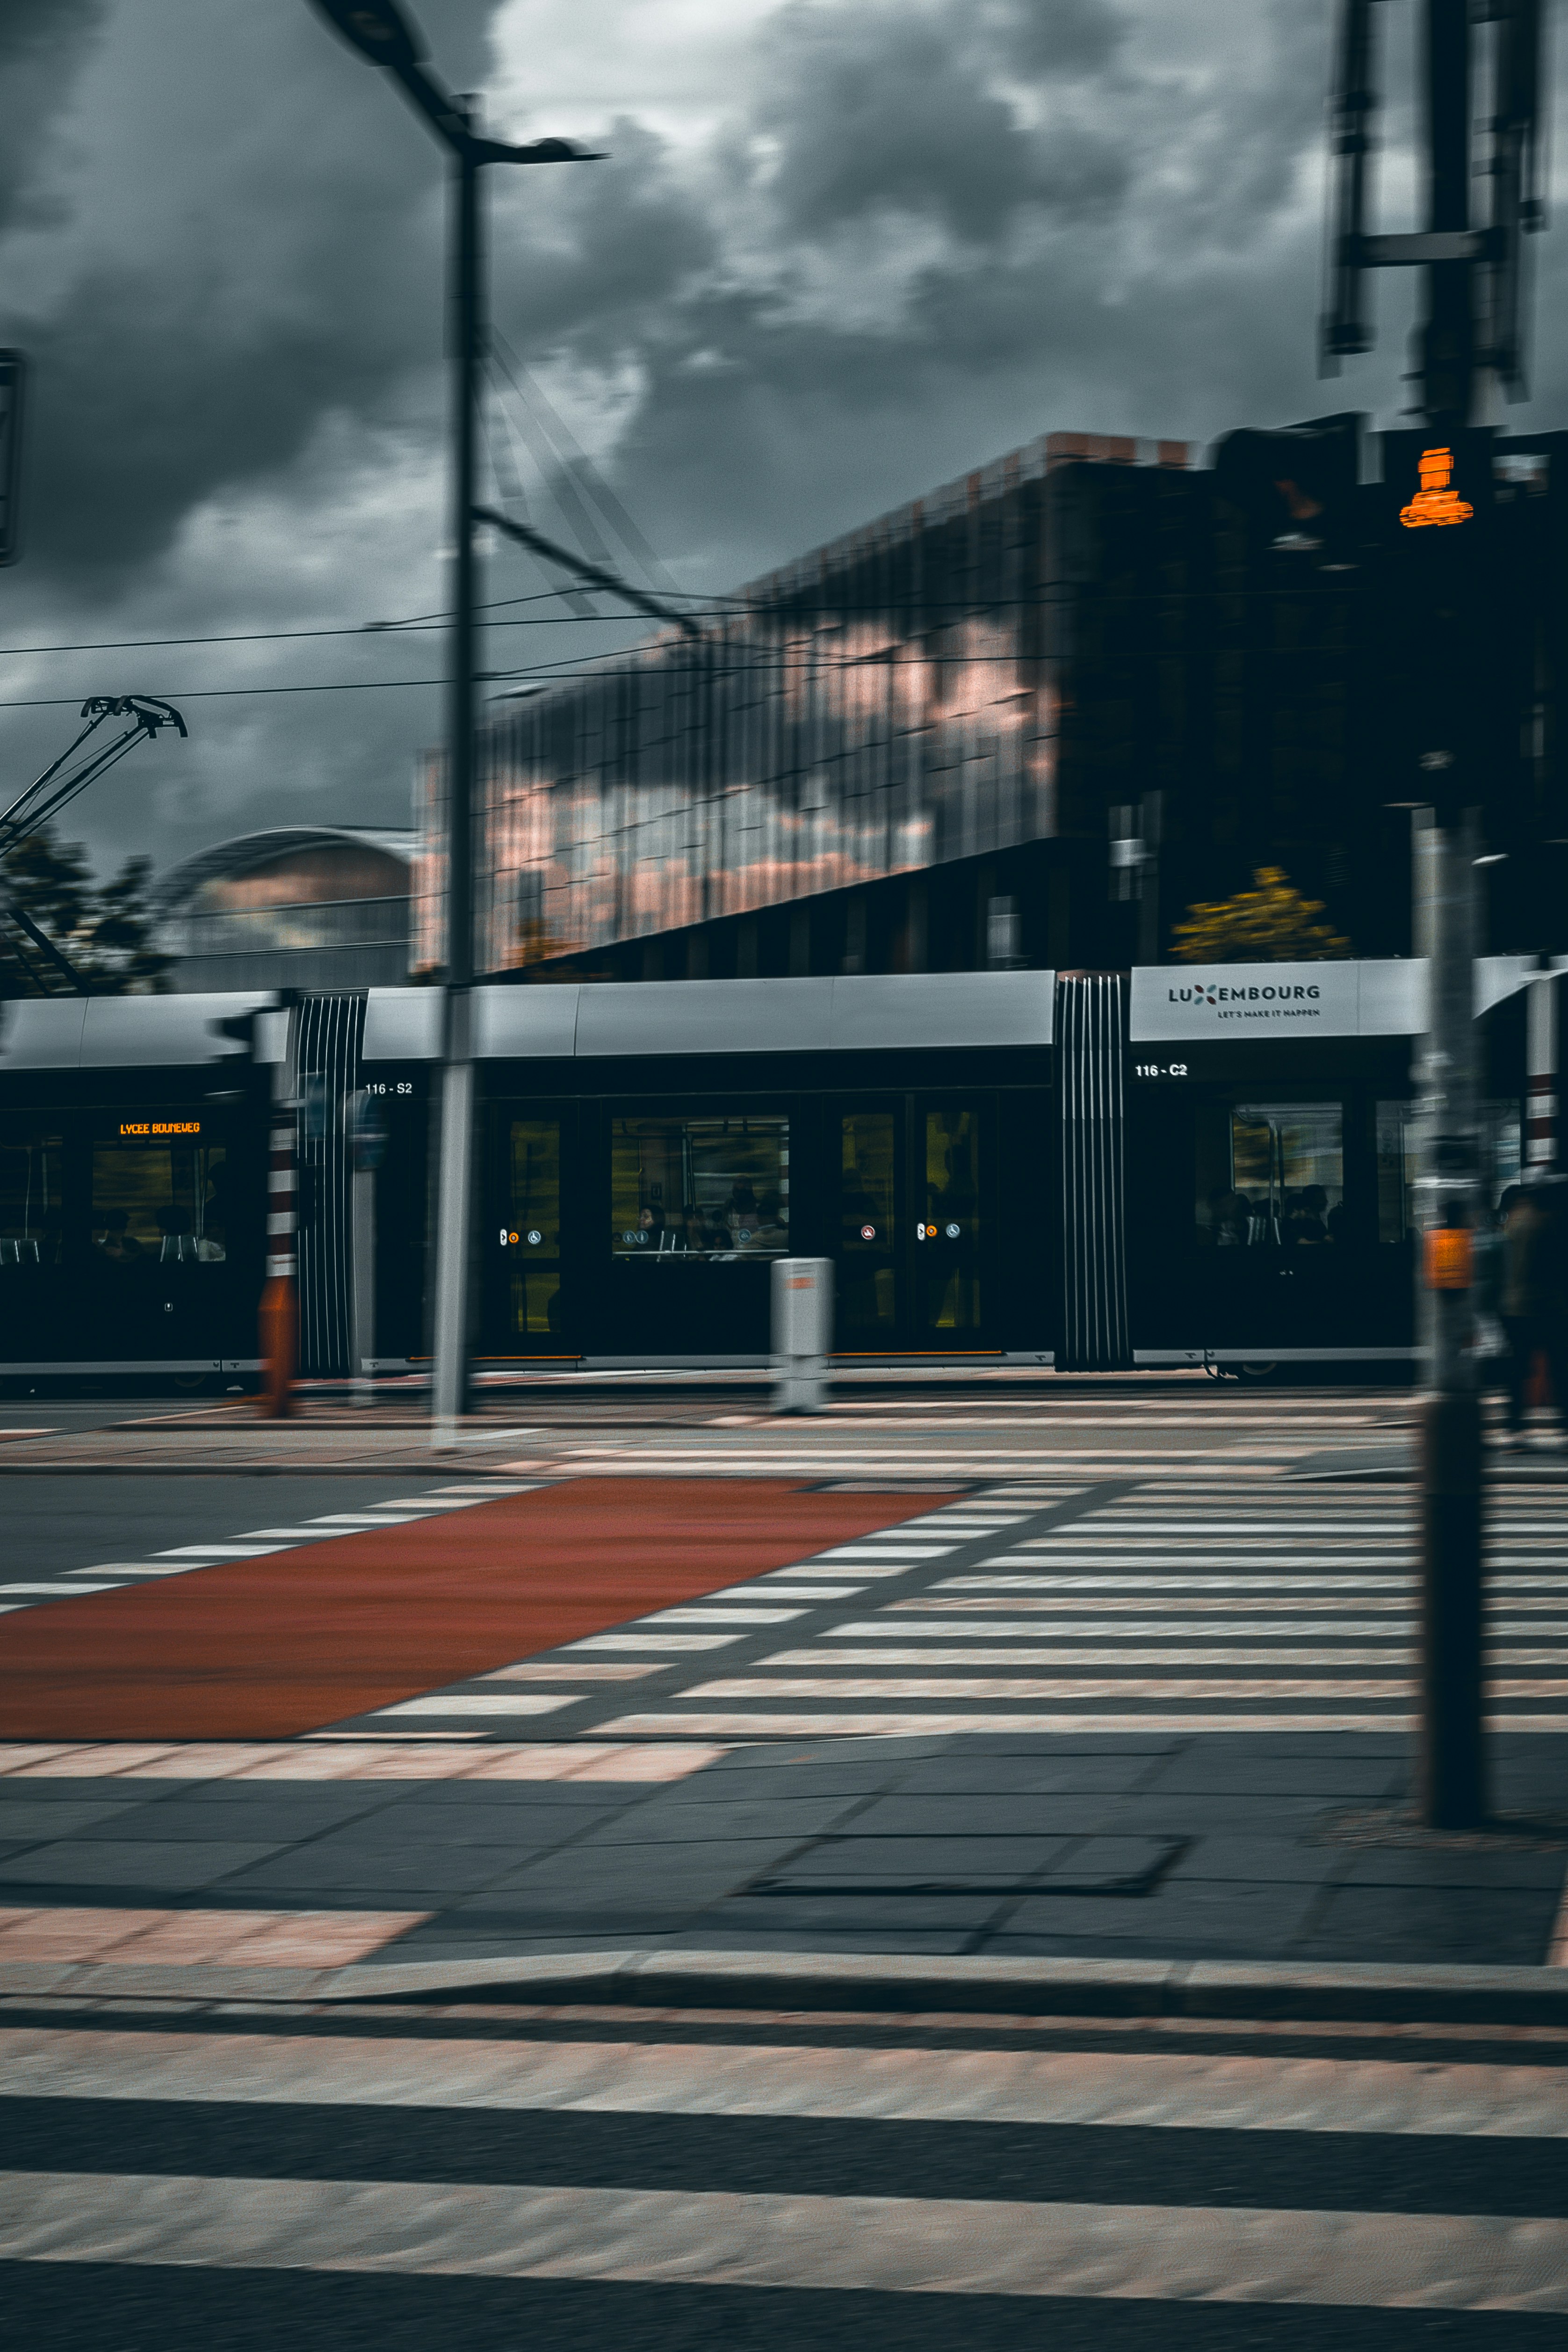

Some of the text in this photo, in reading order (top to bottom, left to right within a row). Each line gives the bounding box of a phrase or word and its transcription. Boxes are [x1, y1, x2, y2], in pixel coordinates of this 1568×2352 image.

[1135, 1065, 1158, 1076] 116
[1170, 1064, 1187, 1076] C2
[366, 1084, 386, 1094] 116
[397, 1083, 412, 1093] S2
[120, 1122, 200, 1134] LYCEE BOUNEWEG
